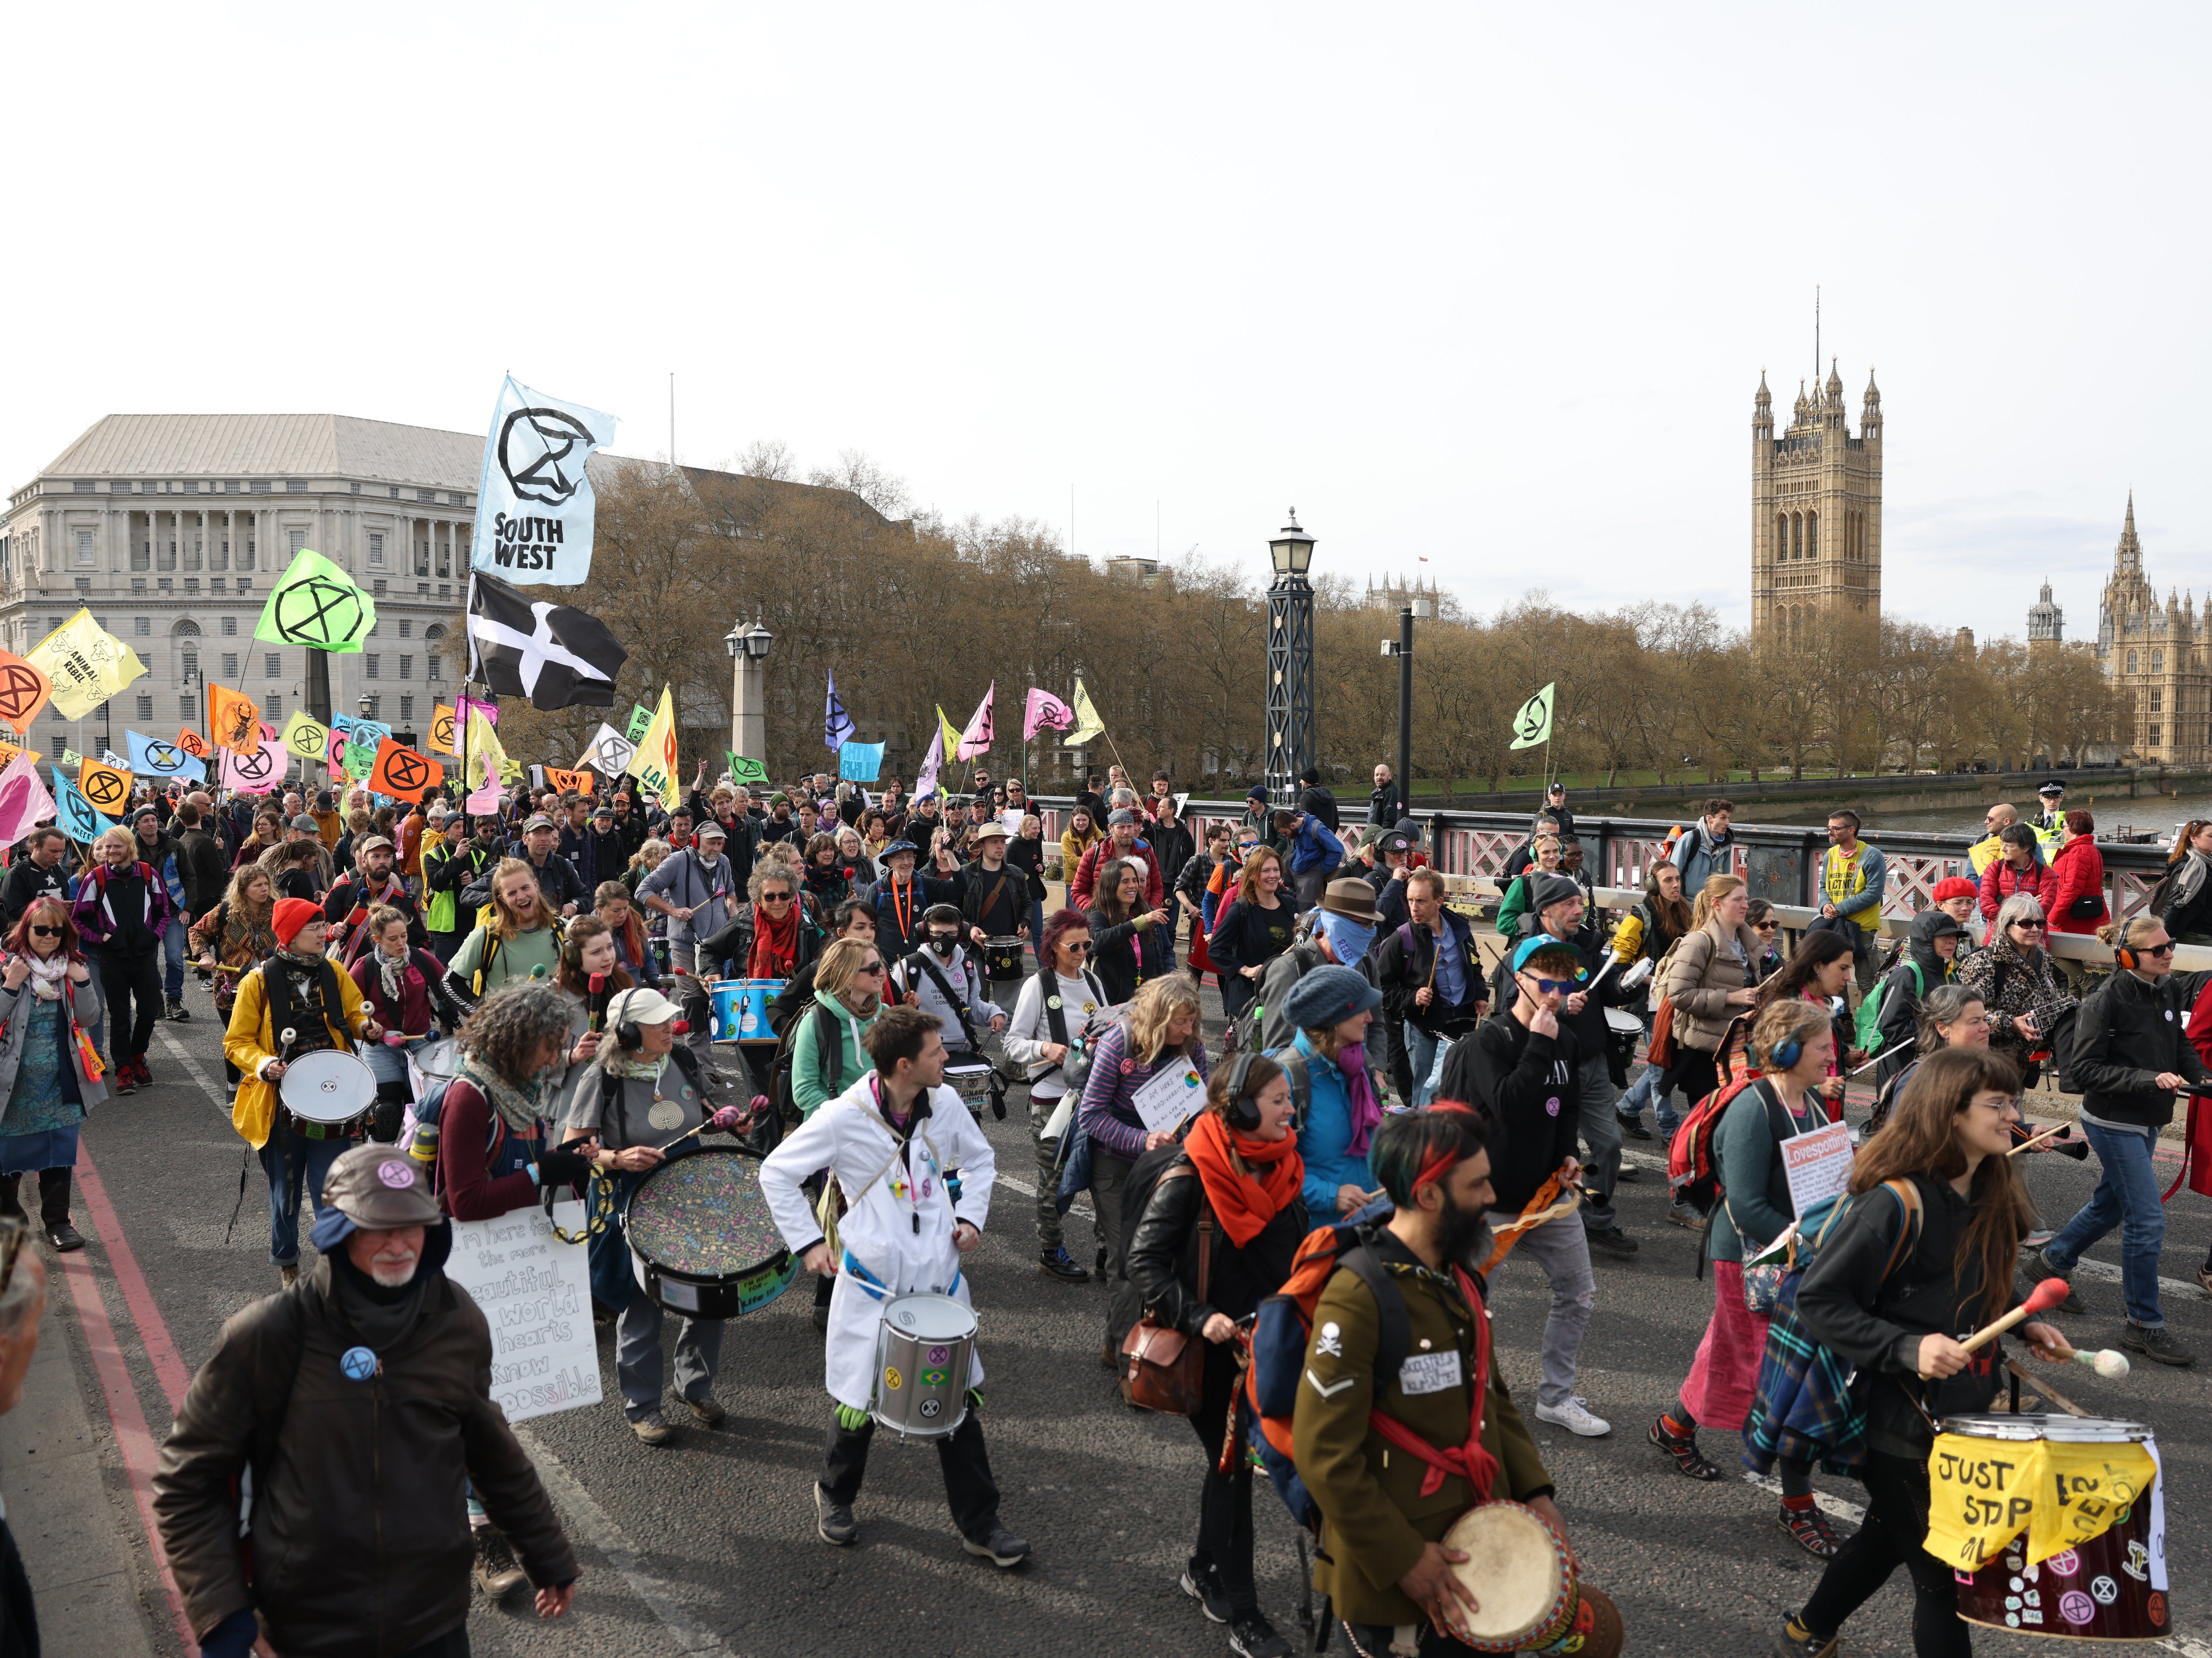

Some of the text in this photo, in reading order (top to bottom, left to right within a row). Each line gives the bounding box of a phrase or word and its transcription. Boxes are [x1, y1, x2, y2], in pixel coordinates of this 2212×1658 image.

[493, 512, 563, 543] SOUTH
[495, 538, 556, 570] WEST
[63, 660, 85, 683] REBEL
[70, 651, 98, 681] ANIMAL
[1337, 939, 1353, 962] REBEL
[963, 1096, 984, 1104] JUSTICE
[1139, 1069, 1185, 1108] I AM HERE FOR
[1153, 1083, 1185, 1111] BIODIVERSITY
[1186, 1087, 1199, 1100] PLANET
[1786, 1133, 1851, 1166] Lovespotting
[451, 1215, 555, 1251] I'm here for
[478, 1244, 547, 1268] the more
[469, 1260, 564, 1304] eautiful
[748, 1283, 762, 1292] FOR
[756, 1270, 771, 1283] HERE
[499, 1284, 579, 1327] world
[742, 1294, 763, 1306] Life
[496, 1319, 572, 1354] hearts
[490, 1356, 549, 1386] know
[497, 1366, 598, 1422] possible
[1939, 1453, 2015, 1491] JUST
